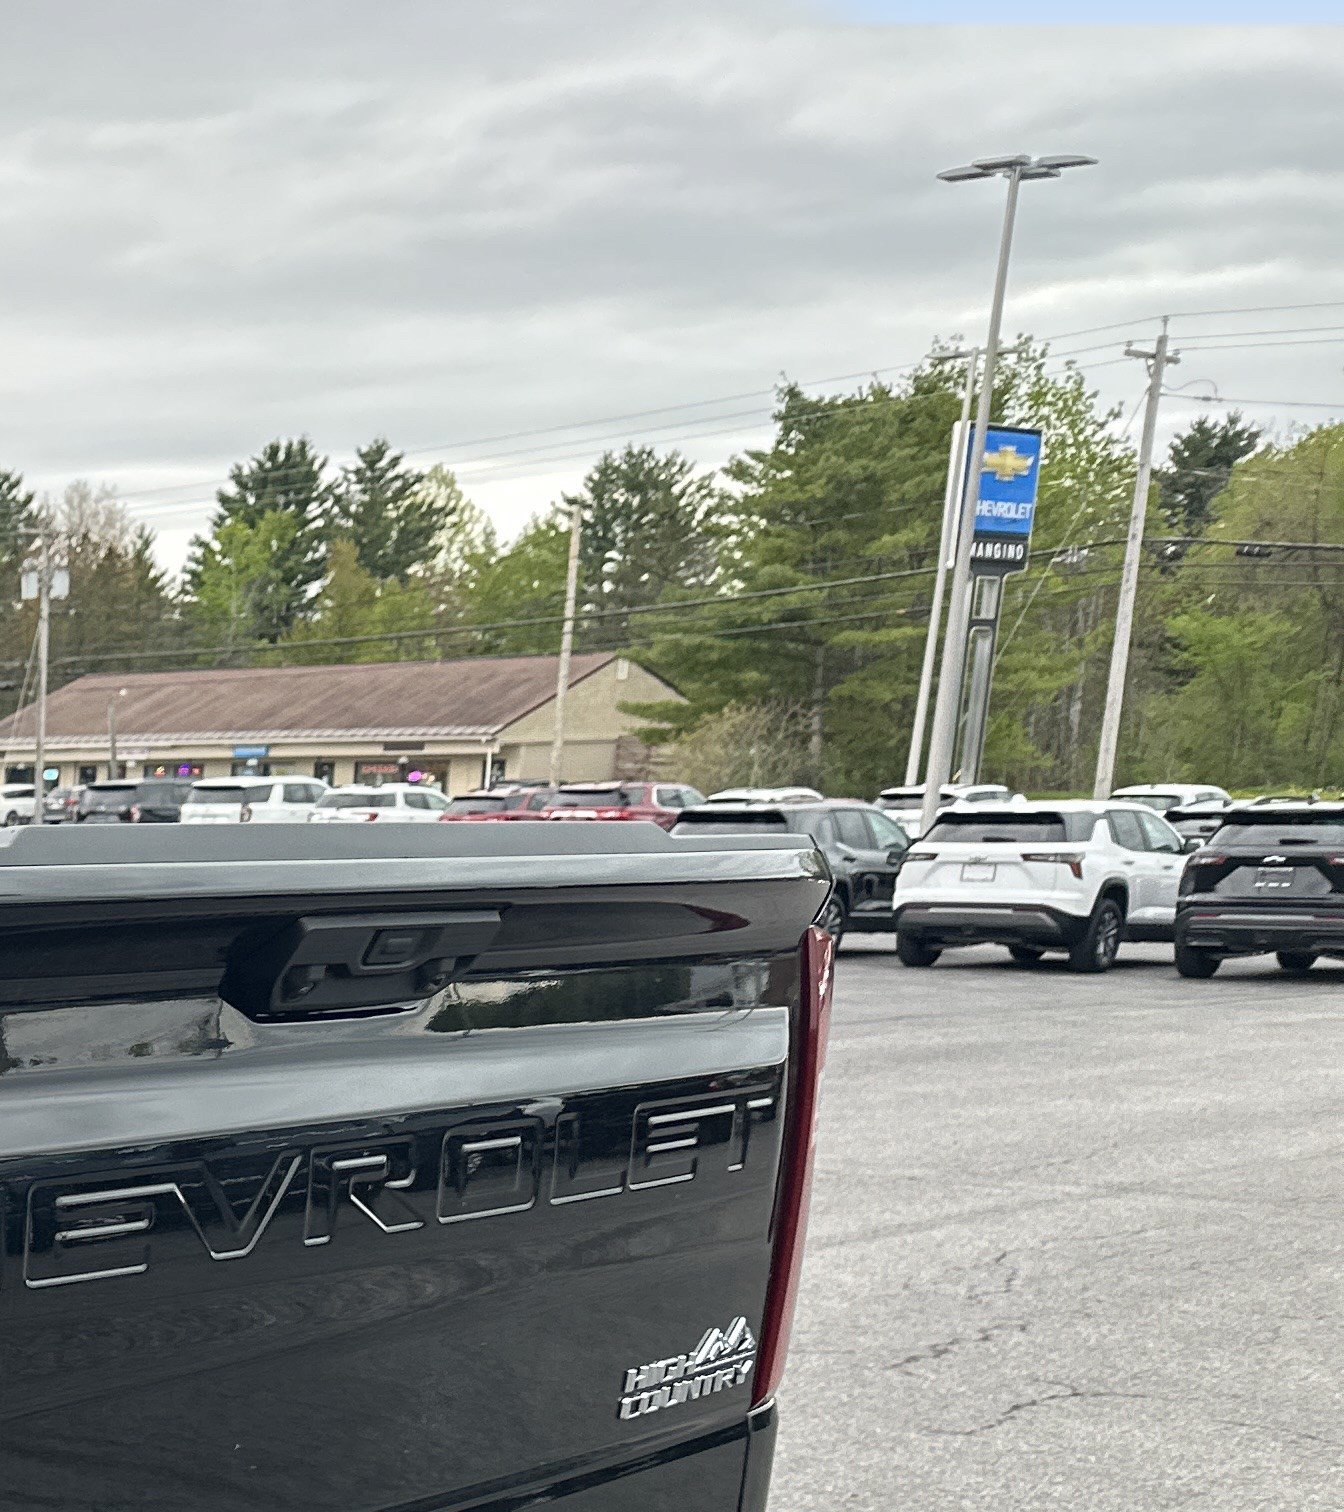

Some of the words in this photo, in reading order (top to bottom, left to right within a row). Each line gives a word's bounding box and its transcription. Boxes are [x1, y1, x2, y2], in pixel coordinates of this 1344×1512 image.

[976, 499, 1033, 519] HEVROLET
[619, 1359, 754, 1420] COUNTRY
[623, 1351, 698, 1394] HIGH
